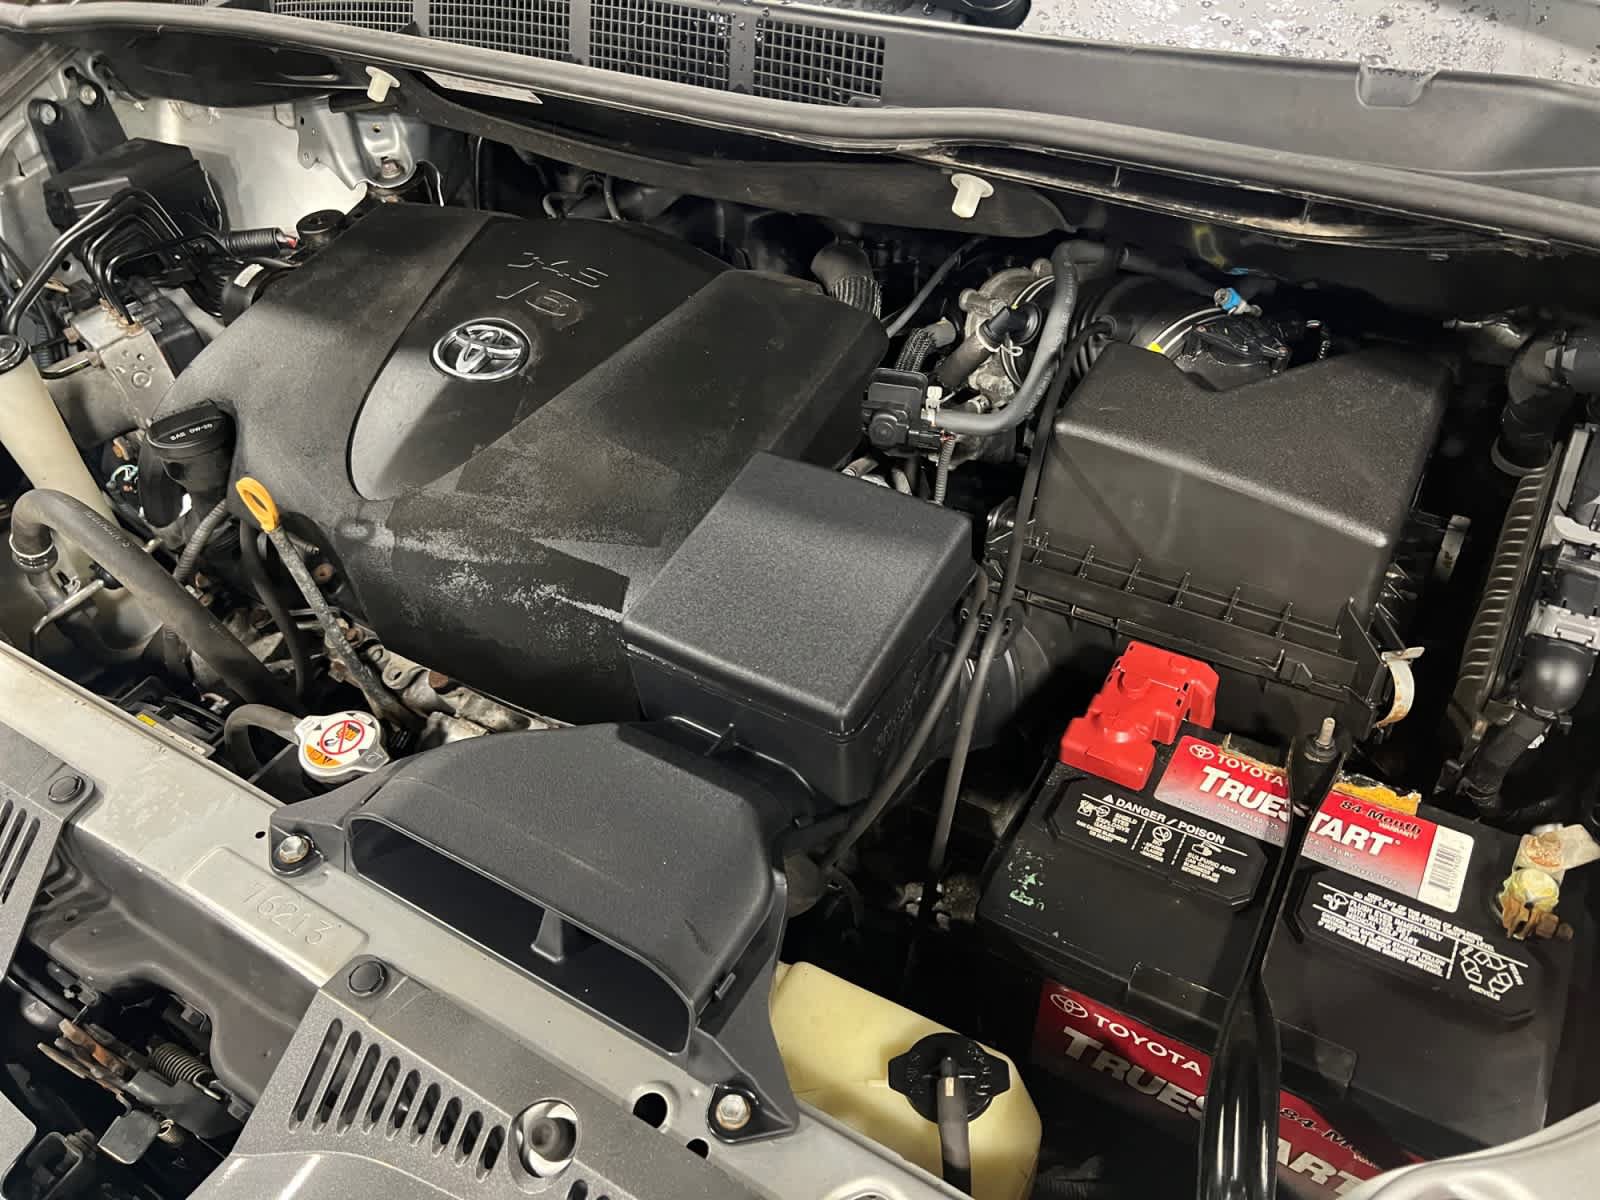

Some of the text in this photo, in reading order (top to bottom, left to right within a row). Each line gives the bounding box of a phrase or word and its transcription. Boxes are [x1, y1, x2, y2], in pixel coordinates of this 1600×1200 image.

[1217, 753, 1284, 787] TOYOTA
[1115, 798, 1166, 823] DANGER
[1177, 820, 1226, 844] POISON
[1340, 801, 1422, 834] 84 Month
[1219, 864, 1236, 875] ACID
[1093, 1013, 1202, 1077] TOYOTA
